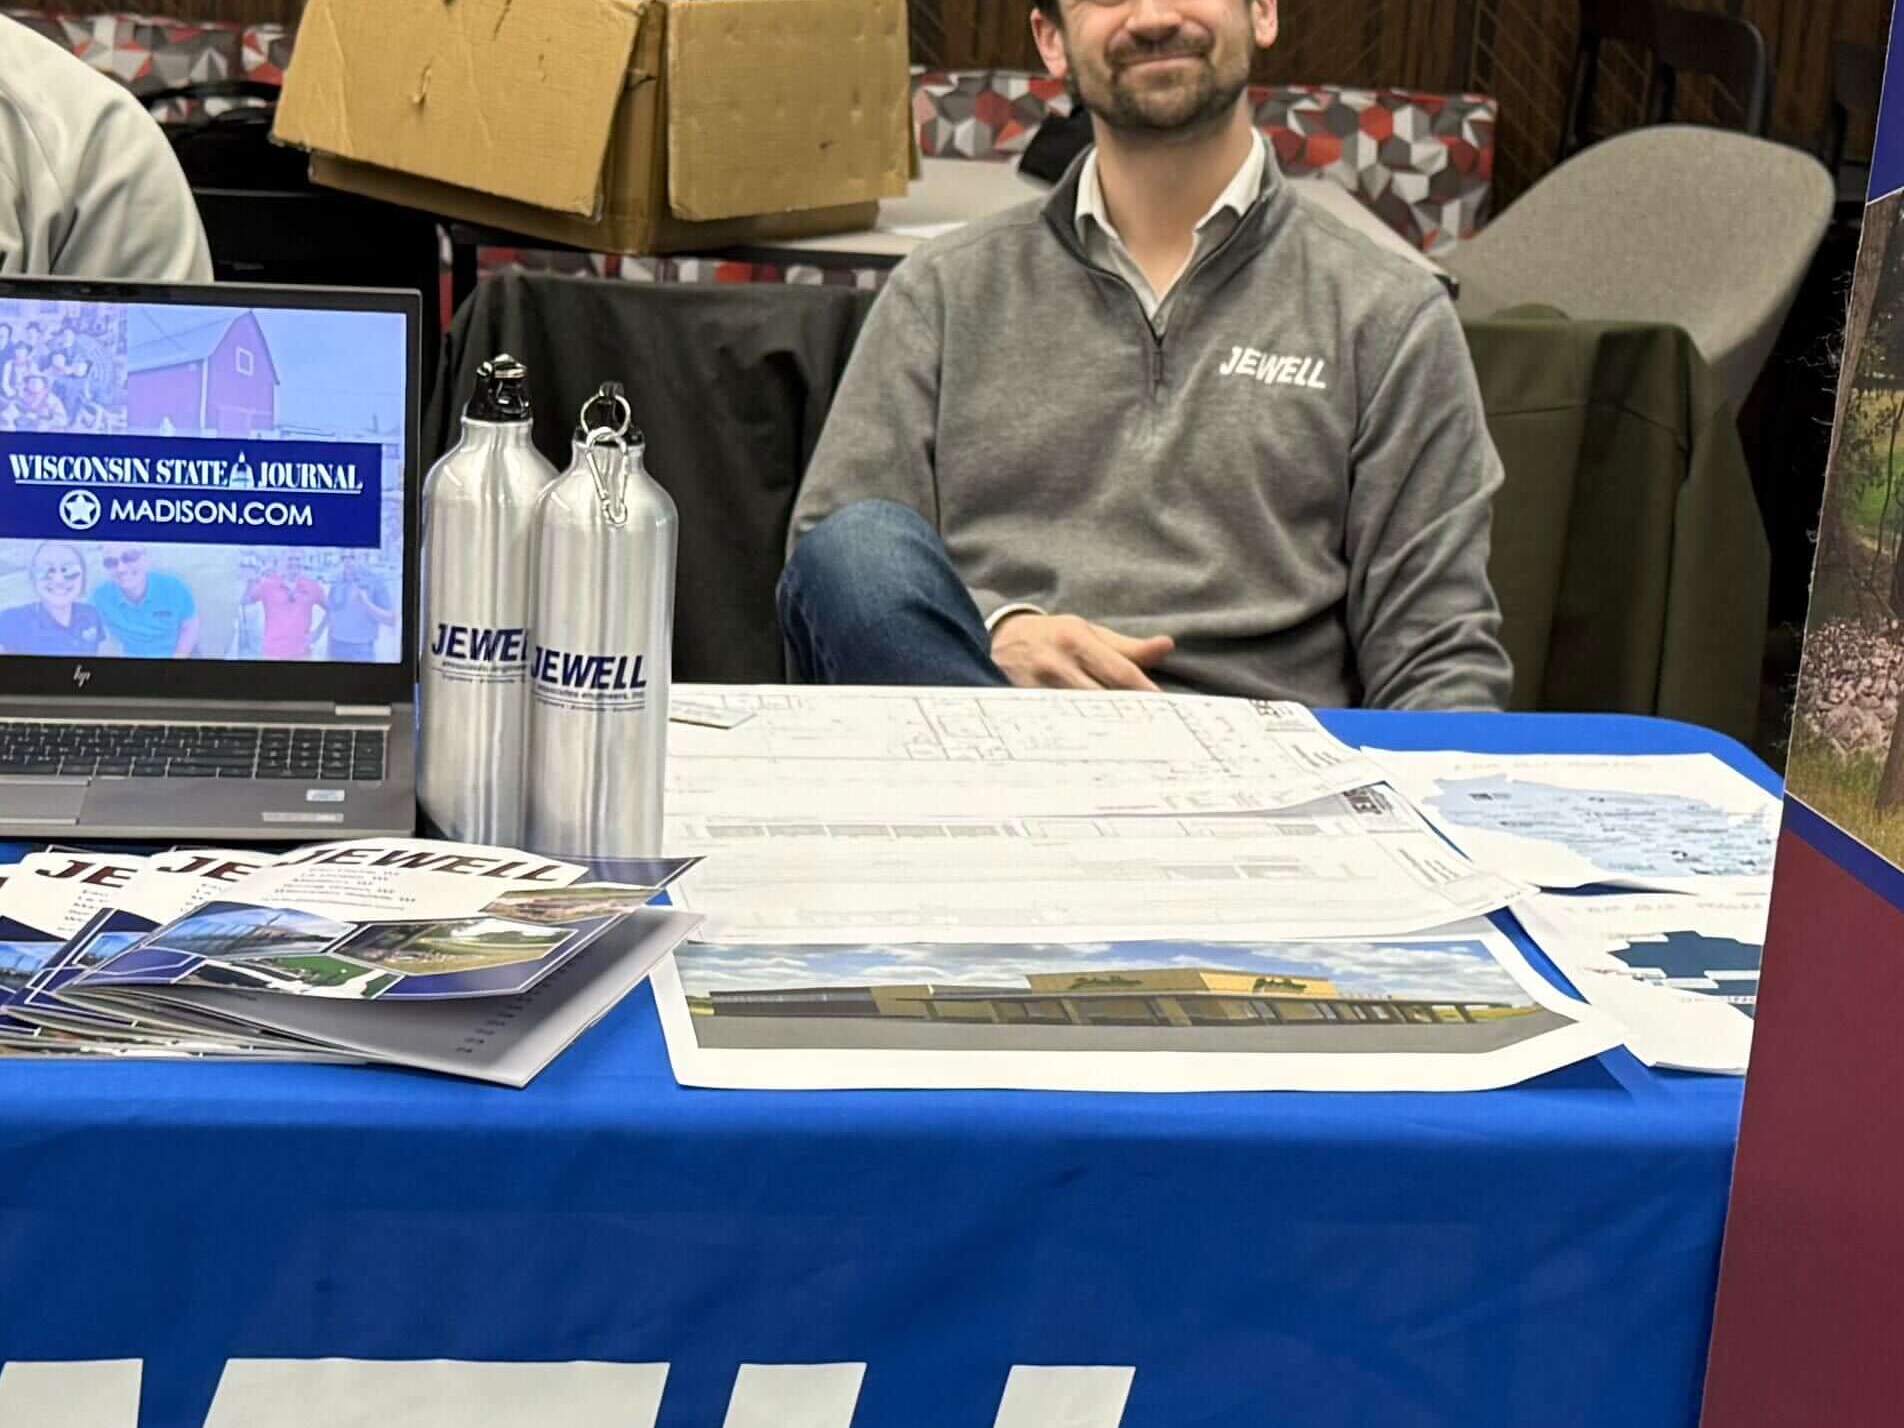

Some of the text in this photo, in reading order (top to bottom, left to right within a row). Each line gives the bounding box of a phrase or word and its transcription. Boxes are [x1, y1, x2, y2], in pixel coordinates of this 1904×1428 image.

[1219, 345, 1327, 389] JEWELL
[9, 453, 364, 490] WISCONSIN STATE JOURNAL
[110, 499, 313, 526] MADISON.COM
[431, 623, 528, 662] JEWE
[530, 646, 647, 689] JEWELL
[272, 848, 561, 883] JEWELL
